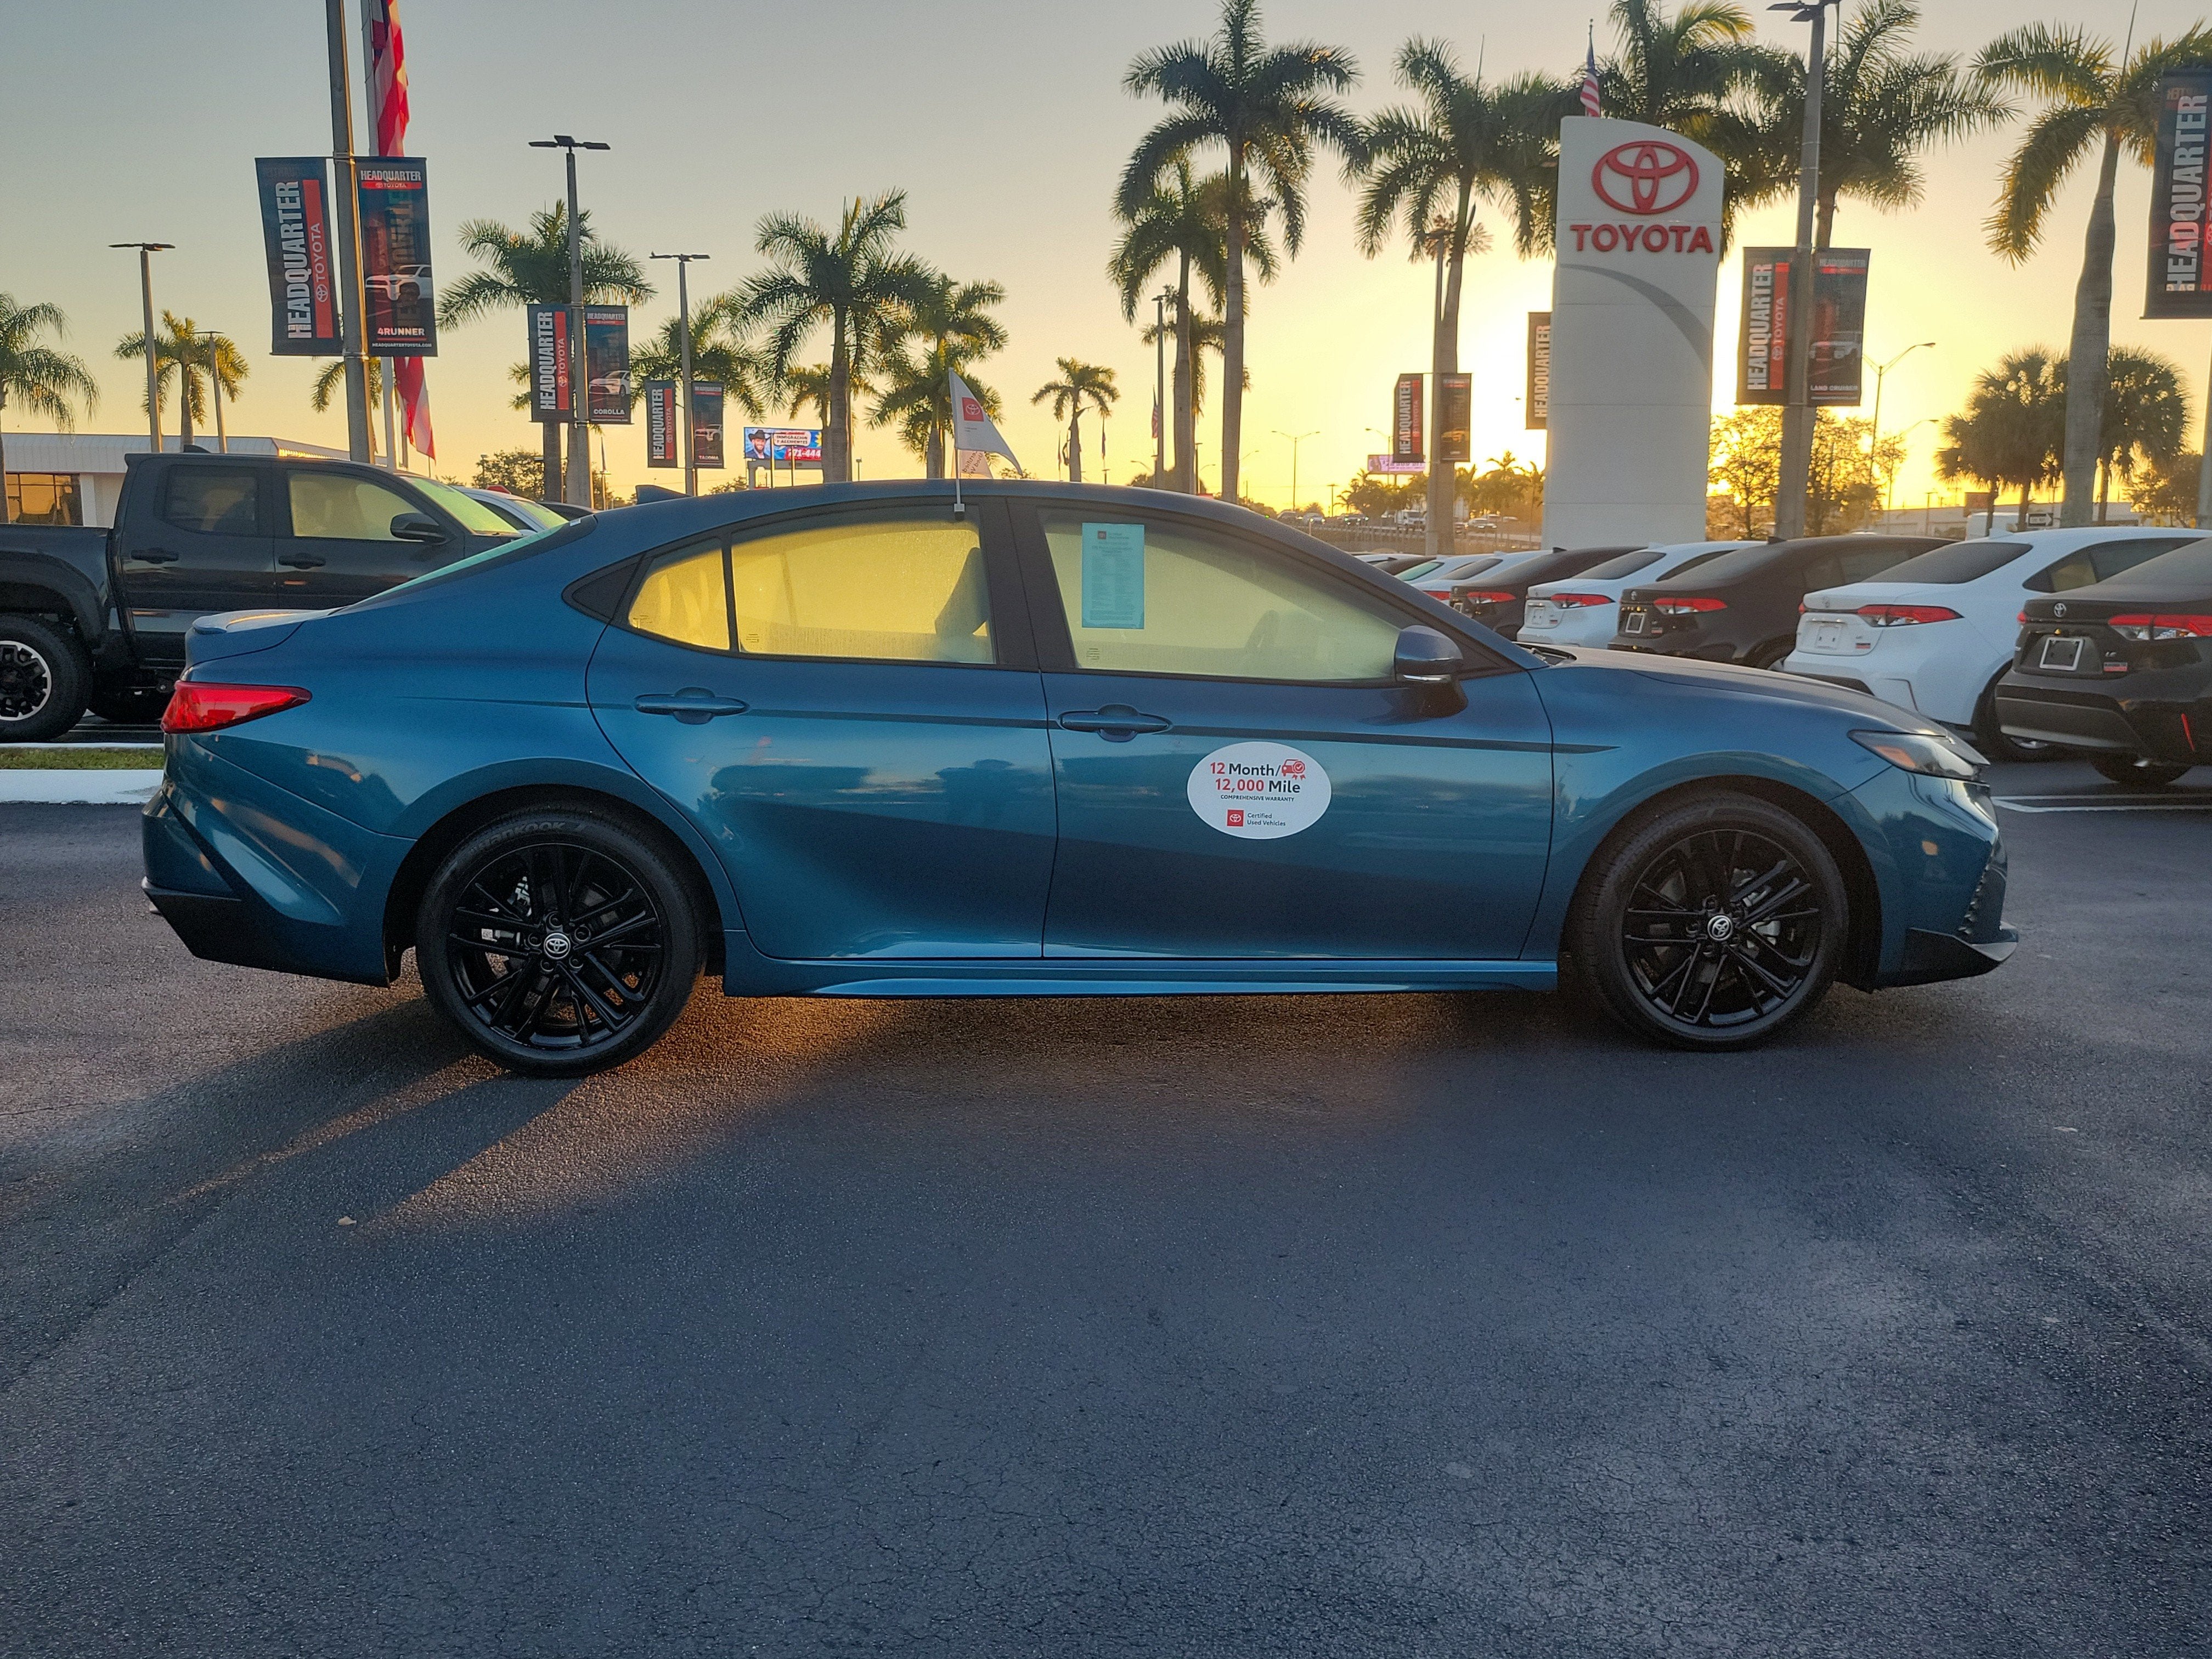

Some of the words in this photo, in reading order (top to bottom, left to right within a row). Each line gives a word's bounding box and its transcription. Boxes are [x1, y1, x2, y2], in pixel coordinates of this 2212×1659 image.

[360, 170, 421, 182] HEADQUARTER
[2166, 94, 2208, 291] HEADQUARTER
[275, 180, 312, 338] HEADQUARTER
[311, 223, 326, 282] TOYOTA
[1570, 224, 1713, 253] TOYOTA
[377, 328, 425, 336] 4RUNNER
[1747, 264, 1773, 390] HEADQUARTER
[1773, 297, 1785, 343] TOYOTA
[537, 312, 557, 410] HEADQUARTER
[557, 338, 566, 374] TOYOTA
[1534, 325, 1550, 418] HEADQUARTER
[652, 388, 665, 459] HEADQUARTER
[1399, 381, 1412, 454] HEADQUARTER
[1210, 761, 1225, 775] 12
[1229, 763, 1281, 776] Month/
[1215, 778, 1264, 793] 12,000
[1269, 780, 1300, 793] Mile
